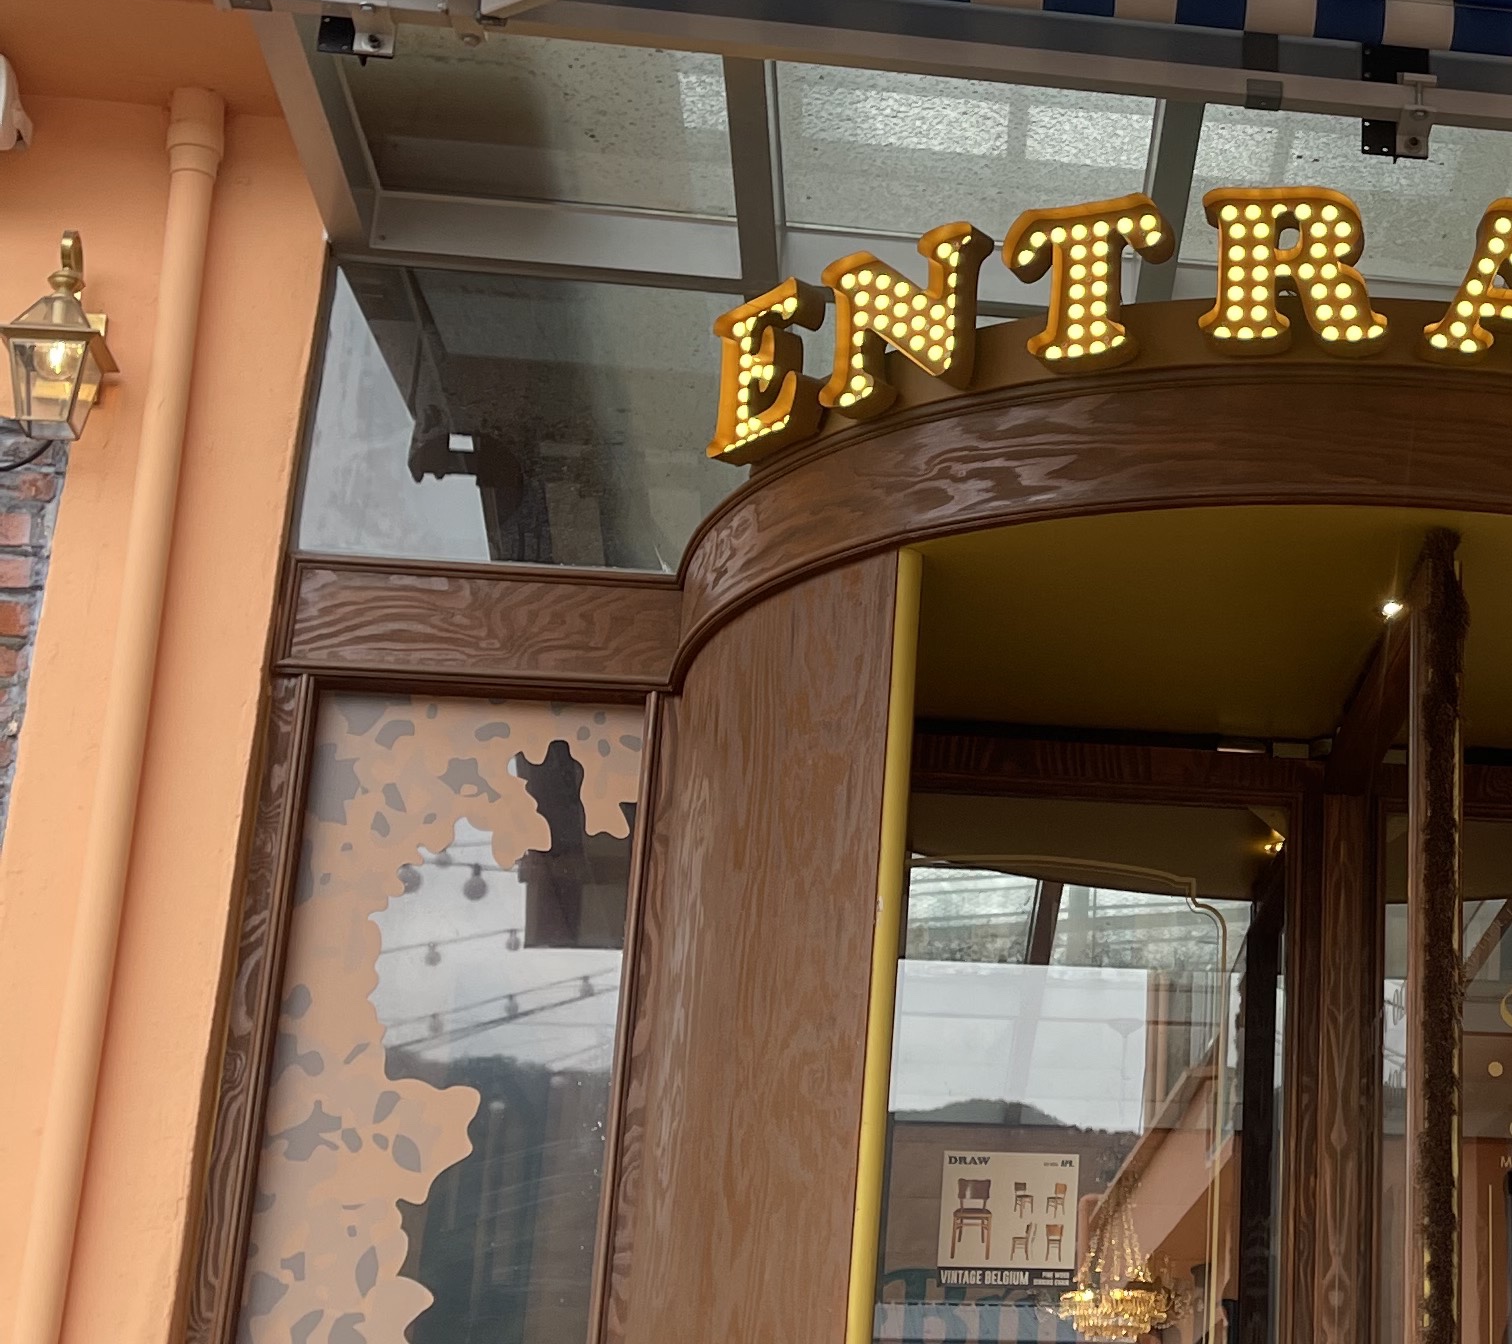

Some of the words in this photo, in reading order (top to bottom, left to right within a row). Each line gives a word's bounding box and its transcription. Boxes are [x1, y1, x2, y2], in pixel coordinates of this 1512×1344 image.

[947, 1155, 991, 1166] DRAW
[940, 1269, 982, 1284] VINTAGE
[984, 1270, 1029, 1286] BELGIUM
